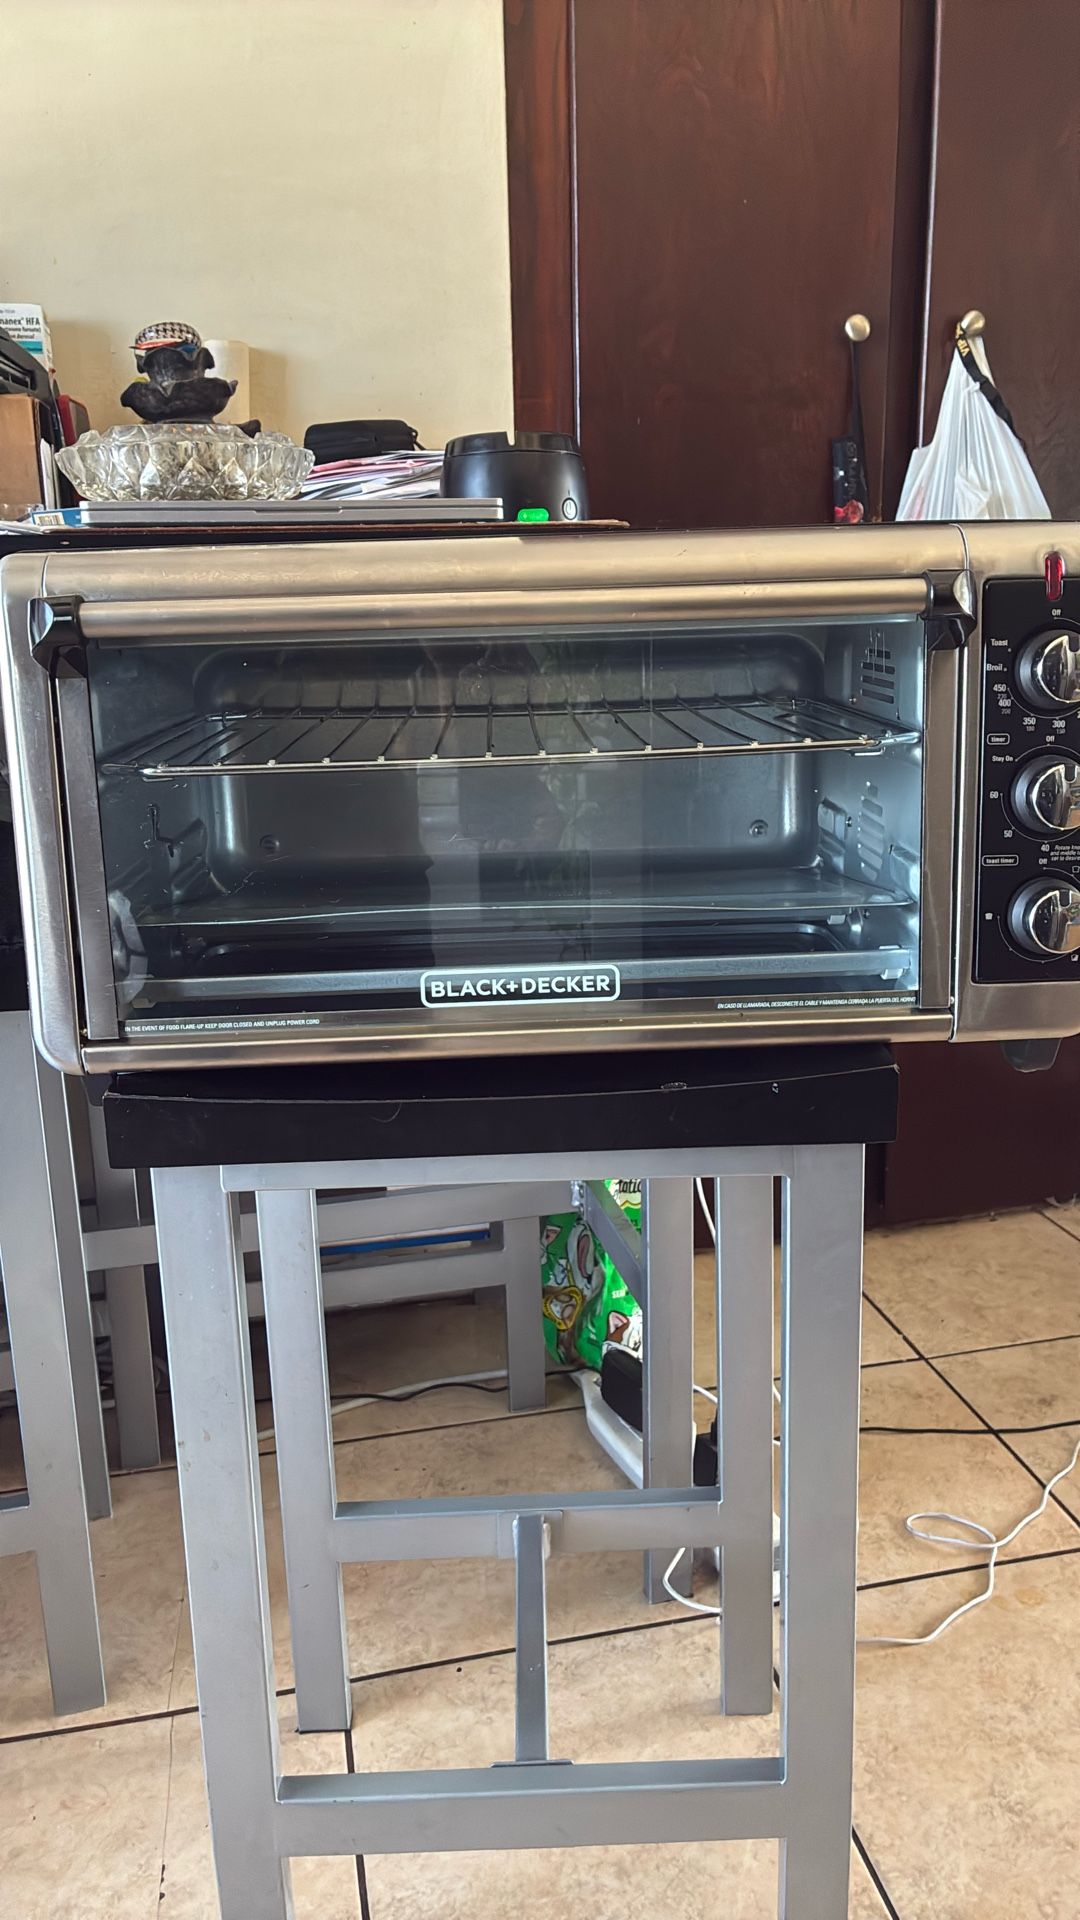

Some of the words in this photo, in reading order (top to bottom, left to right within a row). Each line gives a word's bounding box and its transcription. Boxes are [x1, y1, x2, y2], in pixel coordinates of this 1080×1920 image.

[26, 317, 40, 325] HFA
[1051, 608, 1062, 616] Off
[990, 638, 1008, 646] Toast
[986, 663, 1003, 671] Broil
[993, 684, 1007, 692] 450
[998, 699, 1011, 707] 400
[1022, 717, 1036, 725] 350
[1052, 720, 1066, 728] 300
[1045, 735, 1055, 743] Off
[989, 791, 999, 799] 60
[1003, 830, 1013, 838] 50
[1041, 844, 1050, 852] 40
[430, 975, 611, 998] BLACK+DECKER
